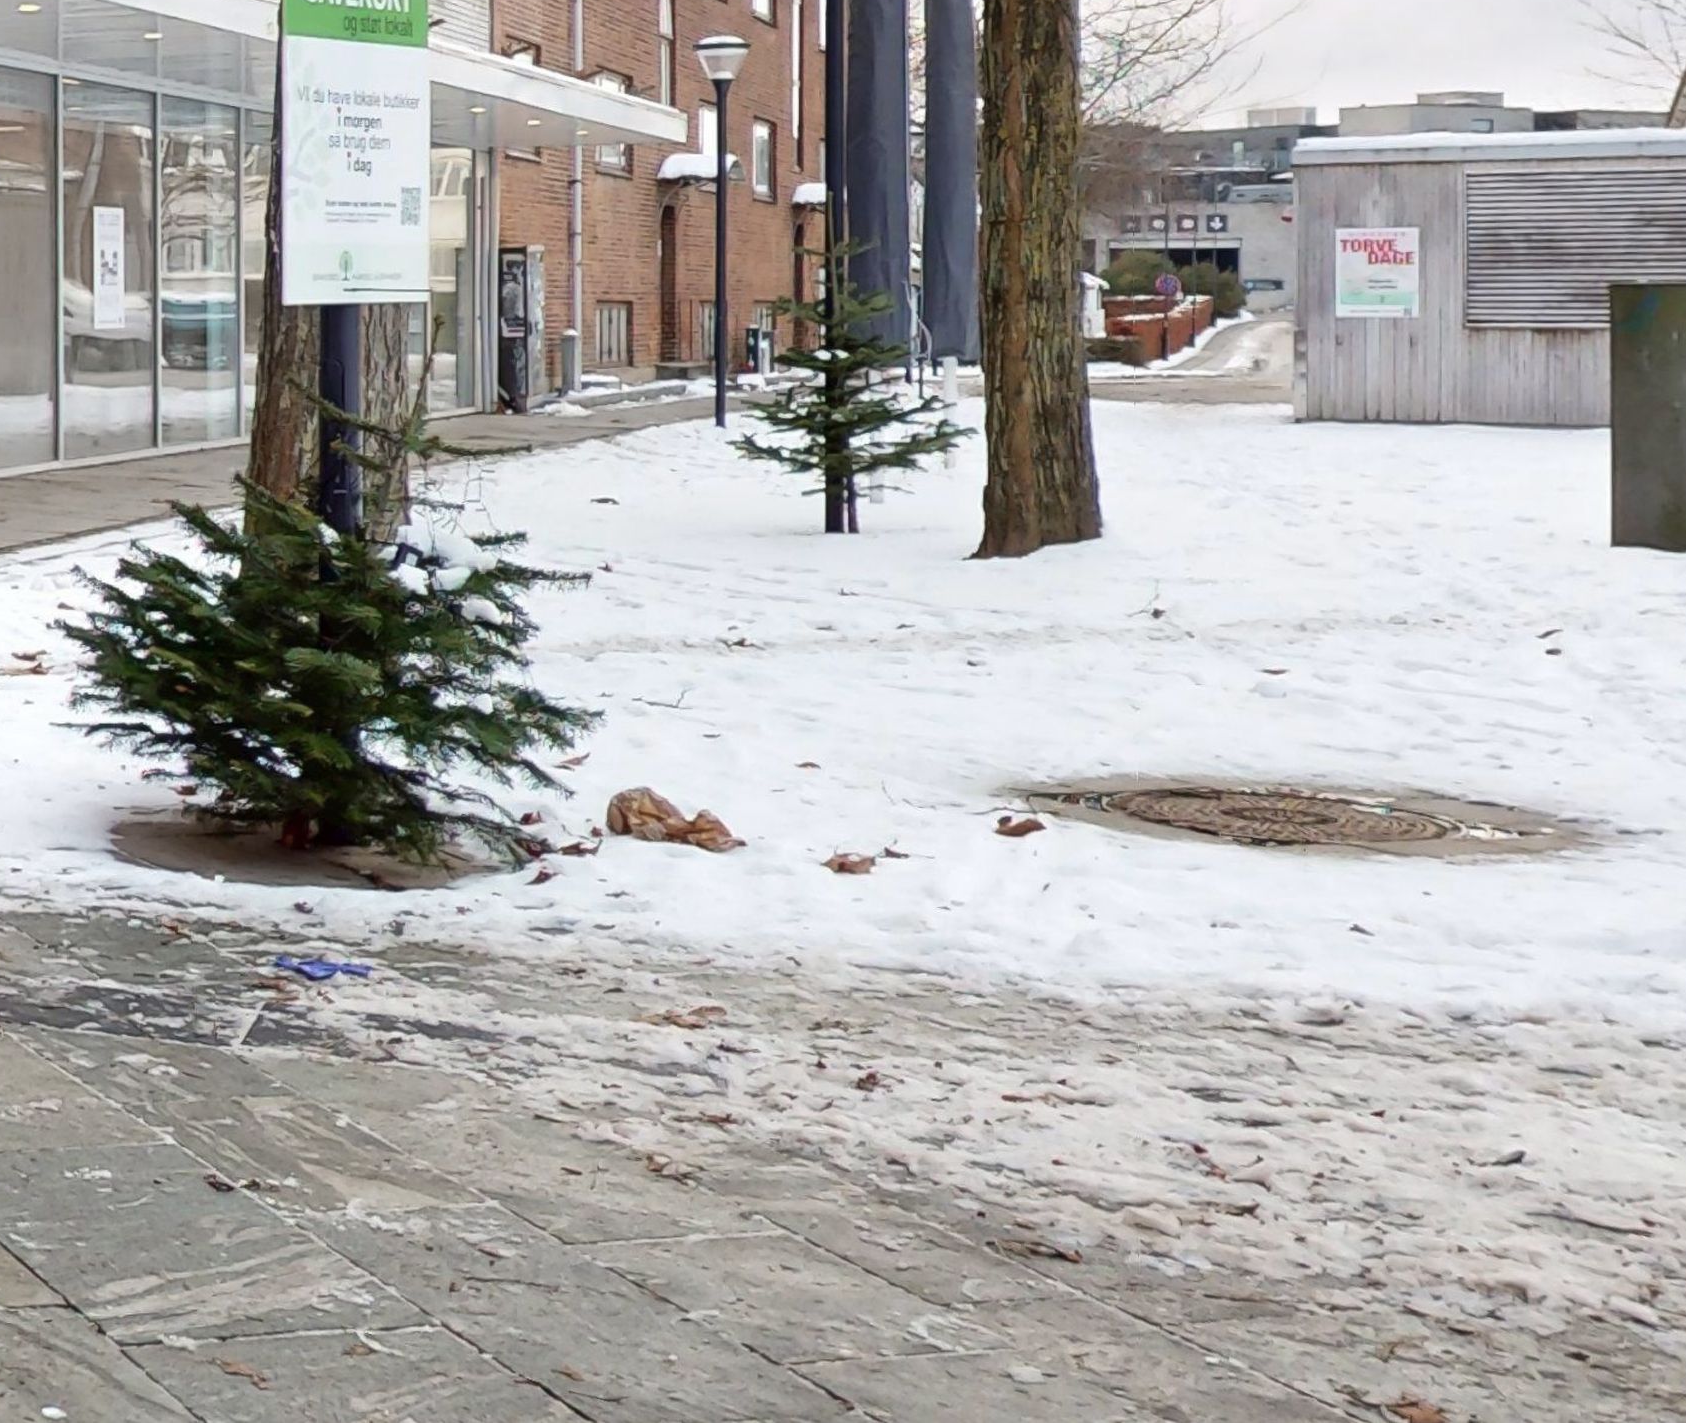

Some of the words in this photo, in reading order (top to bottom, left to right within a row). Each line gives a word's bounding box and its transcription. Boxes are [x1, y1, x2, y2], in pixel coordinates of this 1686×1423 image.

[343, 16, 357, 36] og
[328, 89, 351, 105] have
[343, 116, 383, 133] morgen
[343, 135, 367, 154] brug
[353, 157, 372, 177] dag
[1339, 239, 1398, 253] TORVE
[1368, 250, 1415, 265] DAGE
